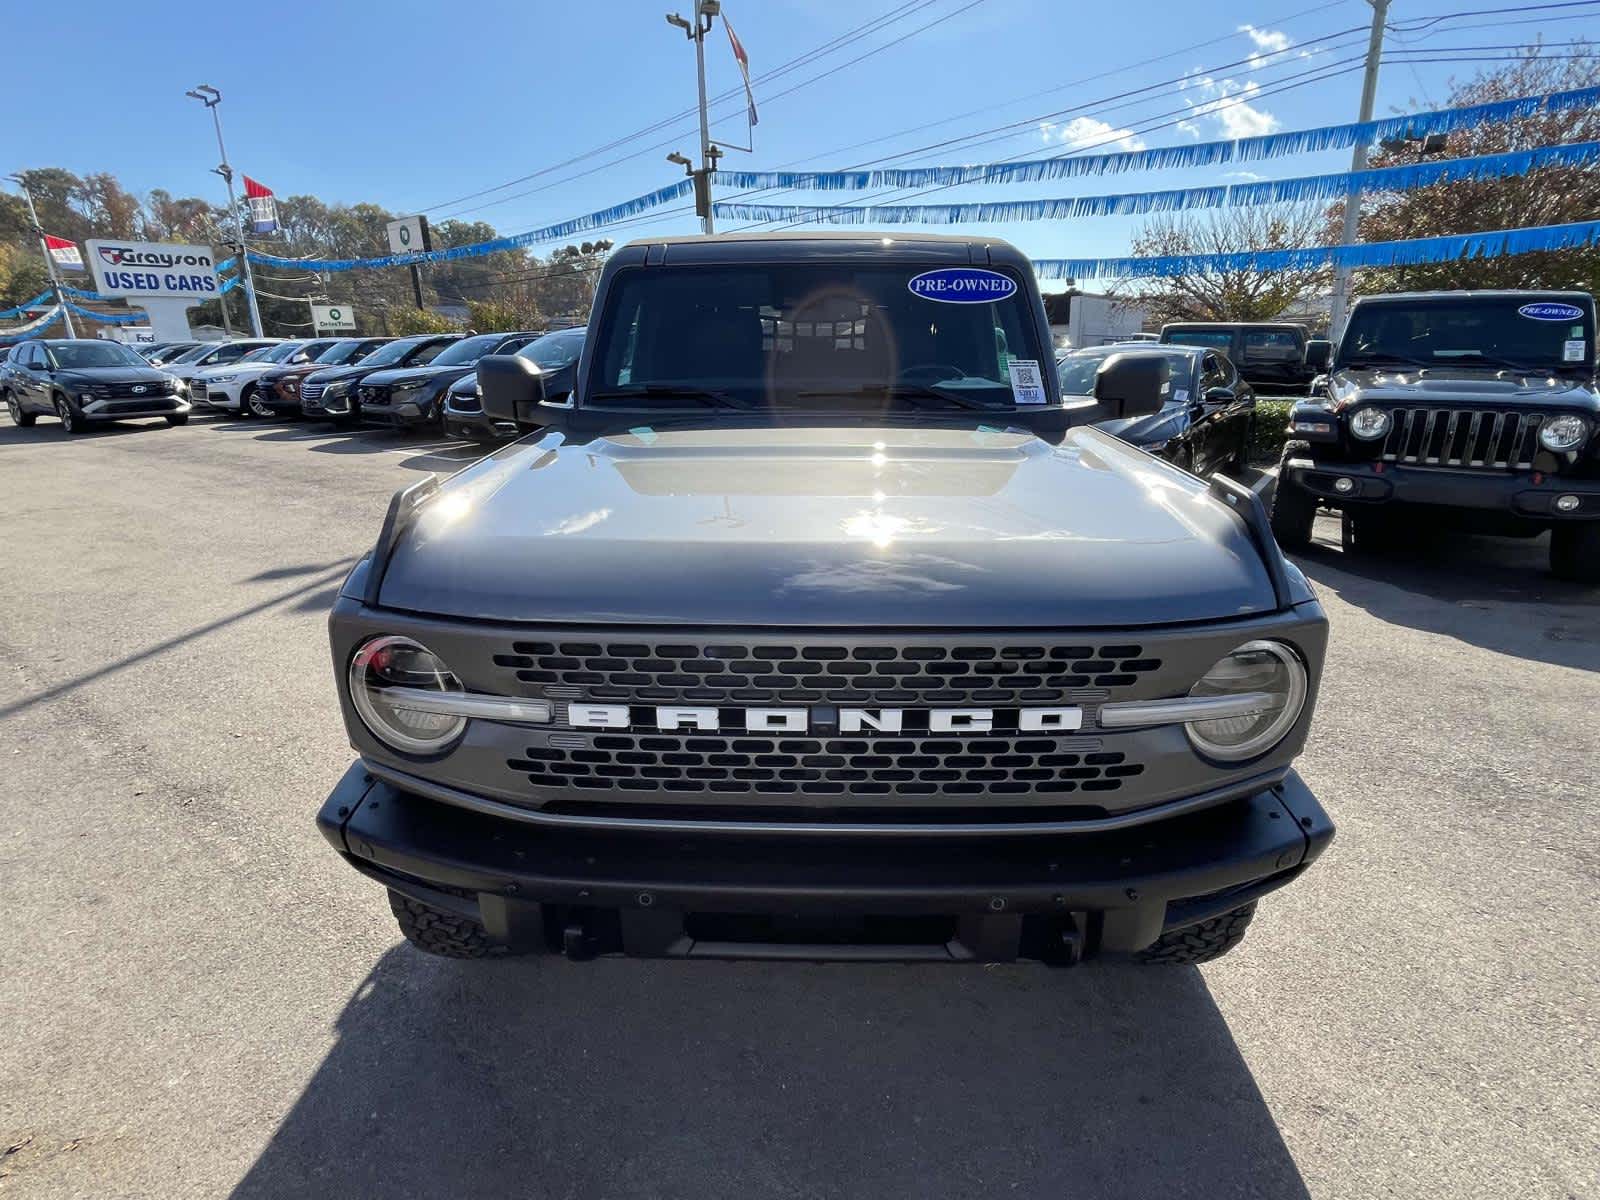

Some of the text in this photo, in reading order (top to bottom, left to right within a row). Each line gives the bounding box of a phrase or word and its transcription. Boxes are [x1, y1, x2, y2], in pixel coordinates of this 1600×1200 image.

[119, 248, 211, 267] Grayson
[104, 272, 215, 291] USED CARS
[914, 279, 1012, 291] PRE-OWNED
[1522, 307, 1581, 316] PRE-OWNED
[568, 703, 1083, 731] BRONCO
